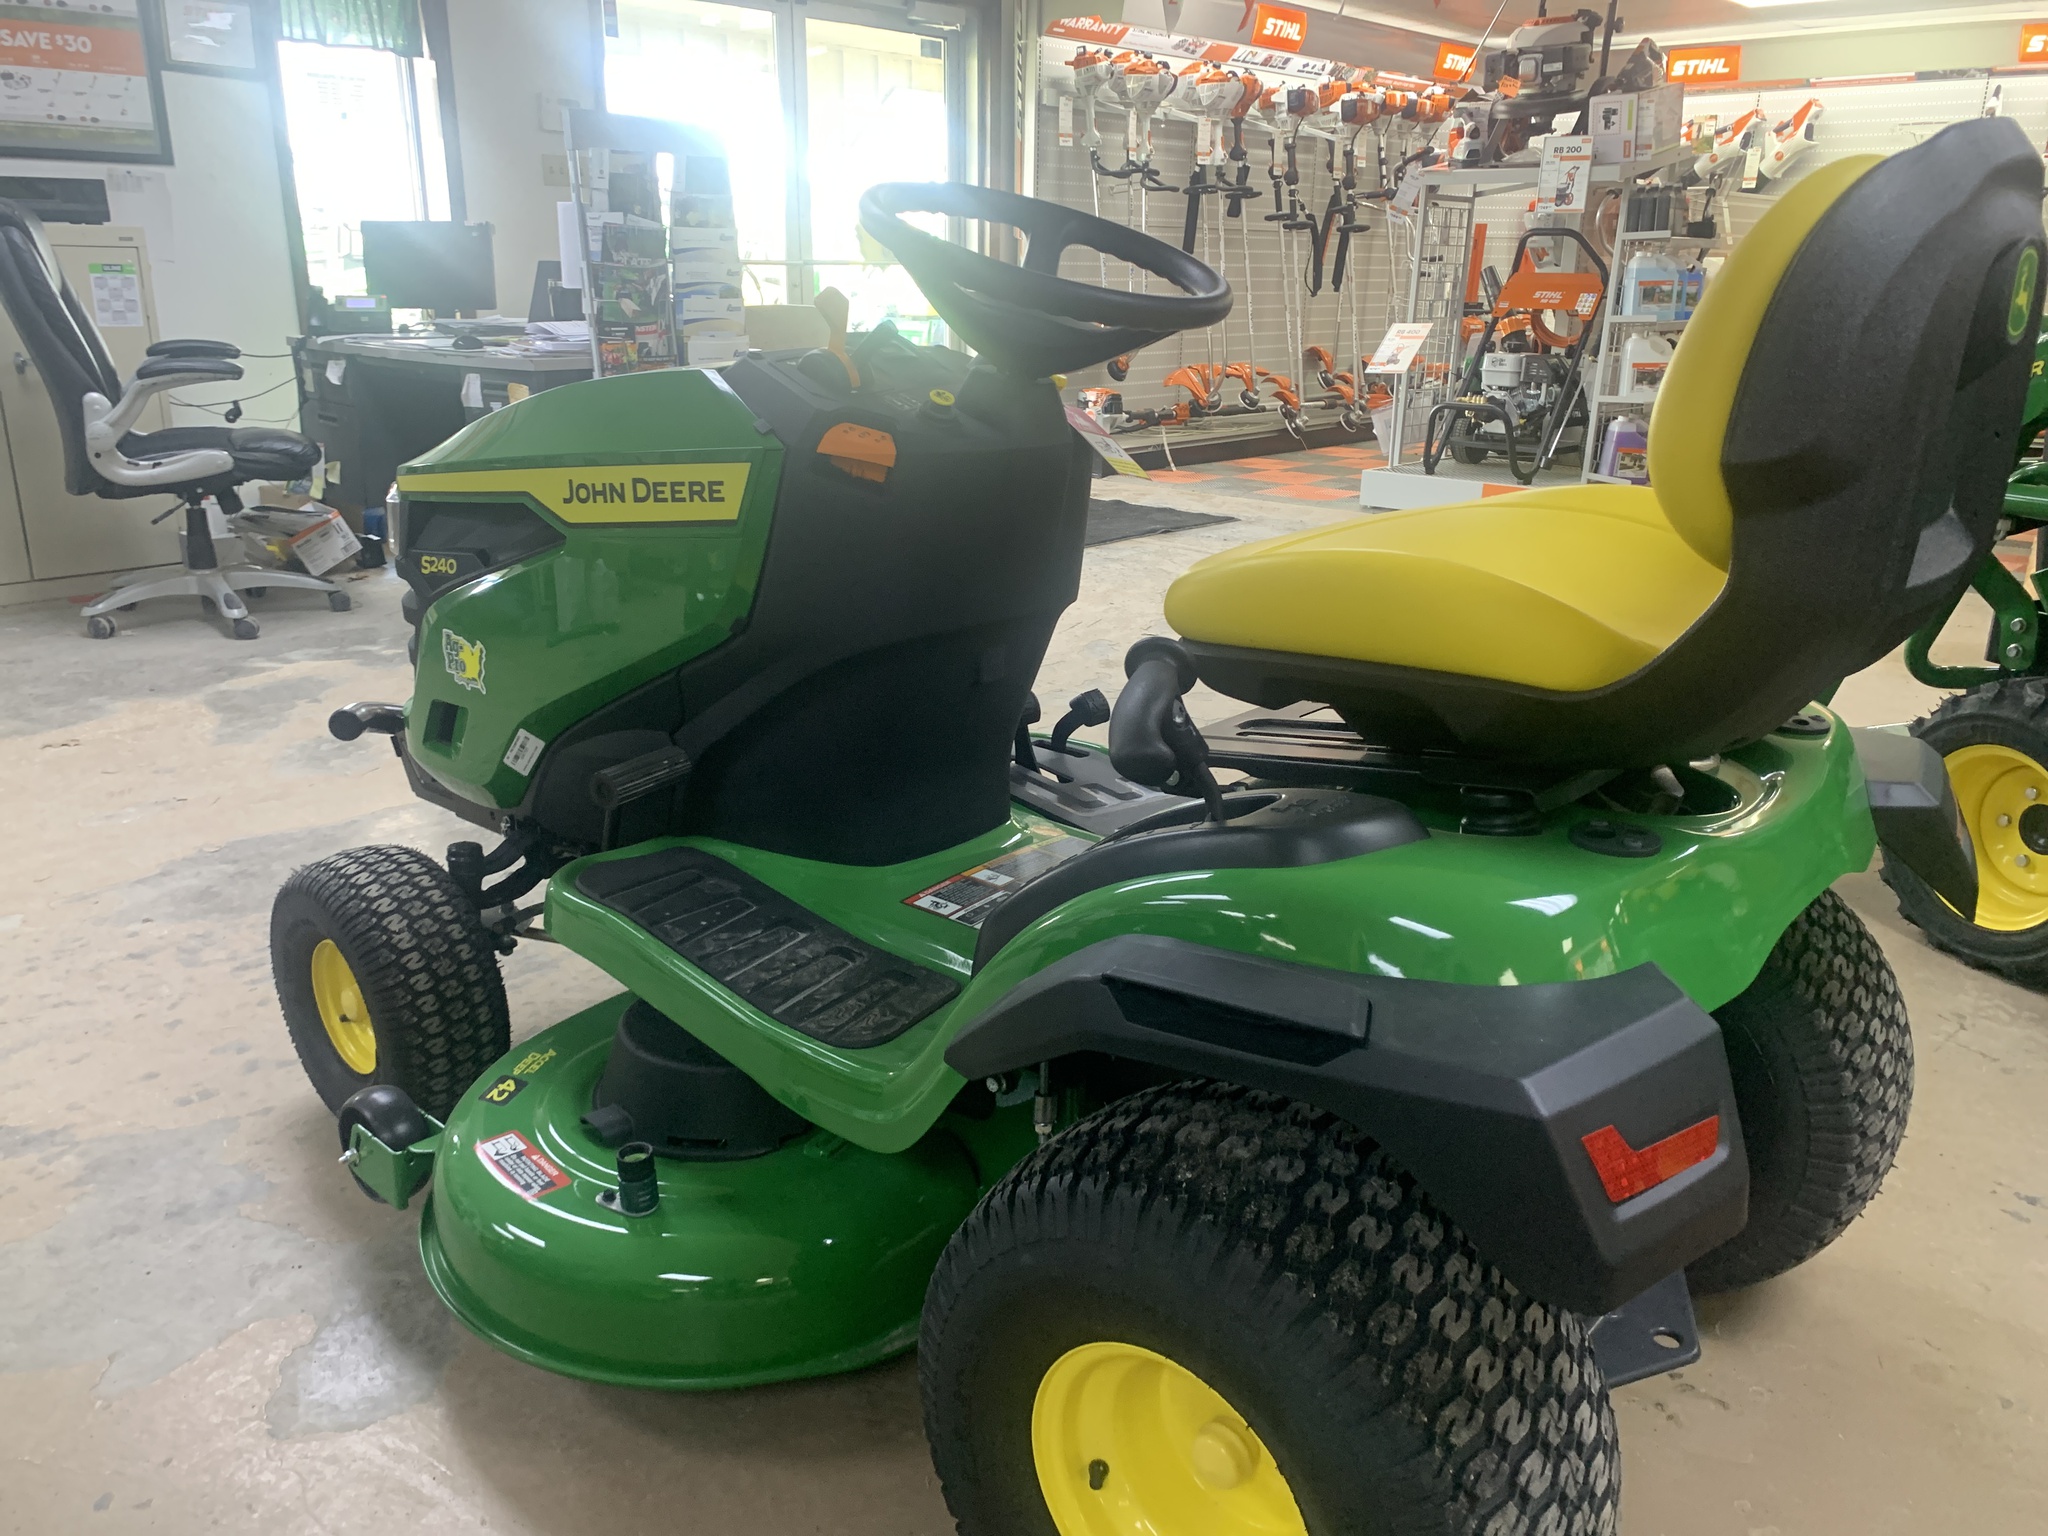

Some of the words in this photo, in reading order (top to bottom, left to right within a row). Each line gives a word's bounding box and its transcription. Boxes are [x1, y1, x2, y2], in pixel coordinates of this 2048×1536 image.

[1060, 17, 1124, 36] WARRANTY
[1263, 18, 1302, 41] STIHL
[0, 29, 53, 50] SAVE
[55, 33, 92, 54] $30
[1671, 58, 1730, 76] STIHL
[1566, 146, 1582, 154] 200
[1533, 291, 1563, 299] STIHL
[563, 479, 625, 504] JOHN
[632, 478, 725, 504] DEERE
[421, 556, 457, 575] S240
[513, 1052, 541, 1075] DEEP
[485, 1079, 516, 1101] 42
[536, 1157, 560, 1178] DANGER
